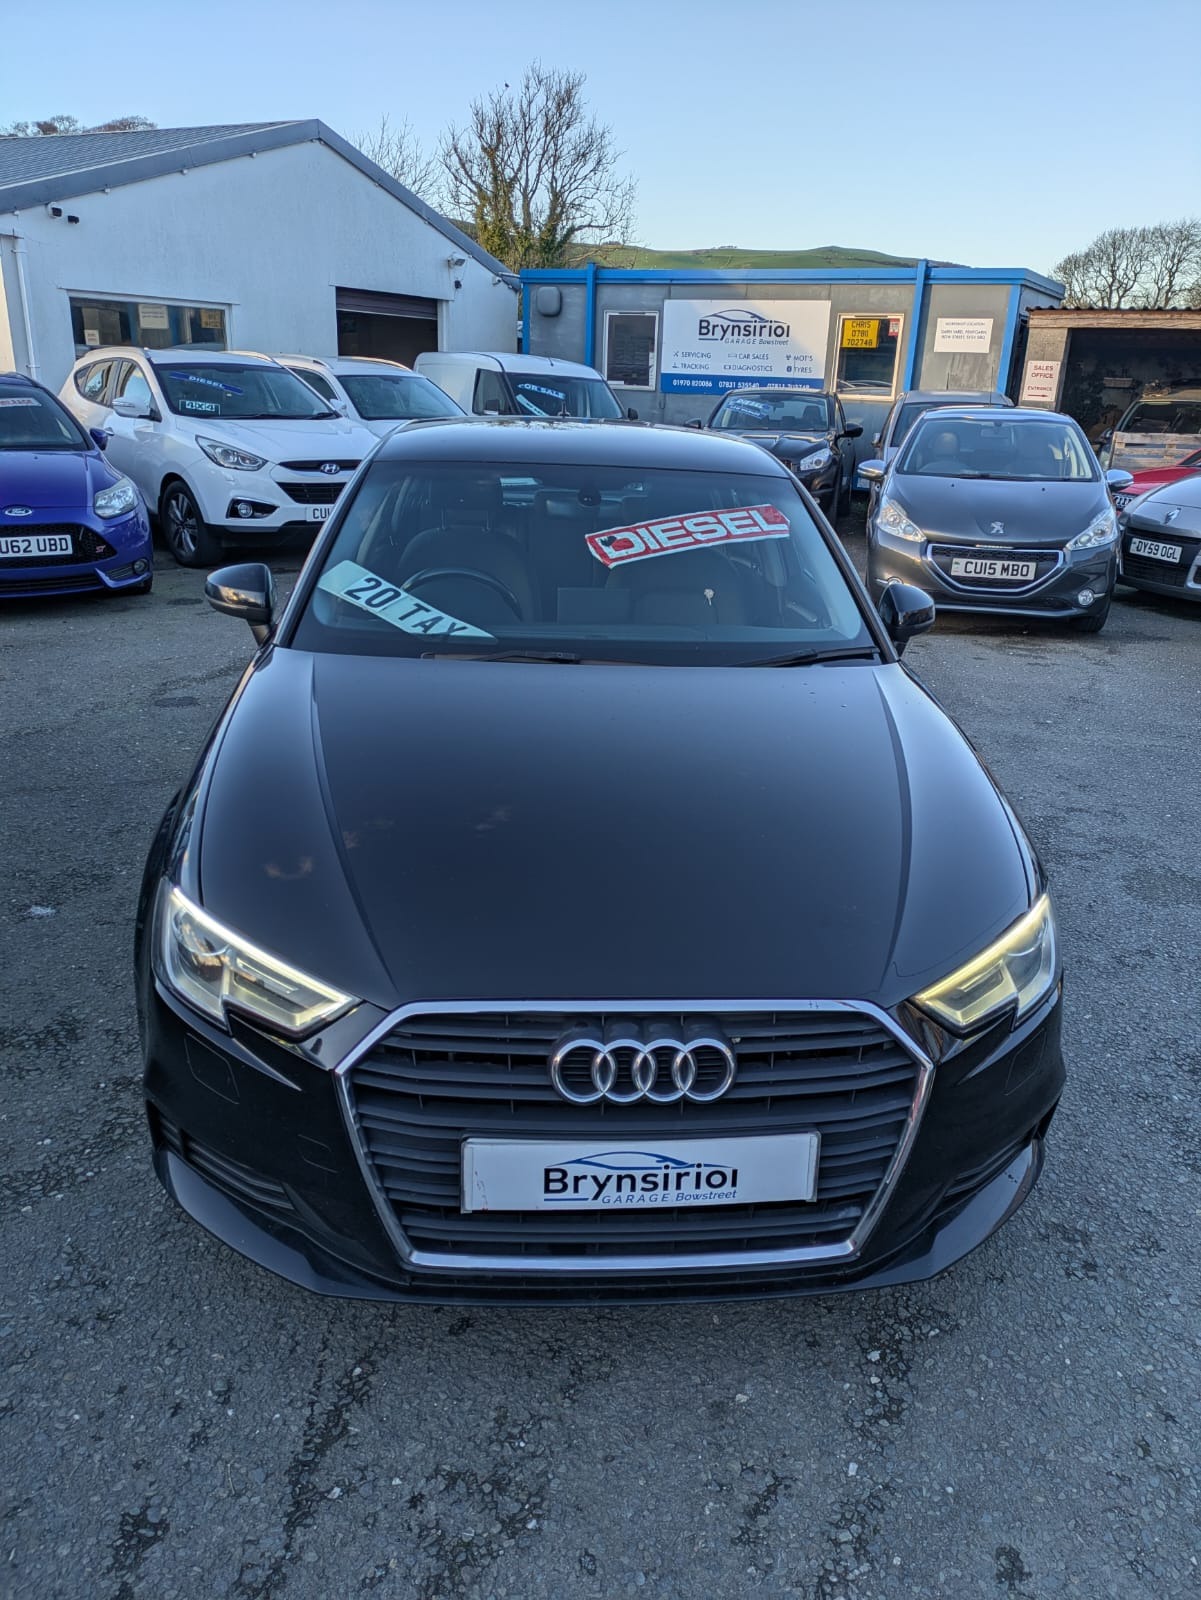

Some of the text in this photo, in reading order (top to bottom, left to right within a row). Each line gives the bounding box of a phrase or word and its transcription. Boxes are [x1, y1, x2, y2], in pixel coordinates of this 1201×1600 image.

[698, 319, 790, 341] Brynsiriol
[681, 351, 712, 359] SERVICING
[752, 353, 769, 361] SALES
[680, 362, 710, 370] TRACKING
[732, 364, 773, 372] DIAGNOSTICS
[794, 366, 812, 374] TYRES
[594, 509, 789, 560] DIESEL
[36, 537, 69, 553] UBD
[1136, 541, 1160, 556] DY59
[963, 560, 998, 576] CU15
[344, 576, 402, 609] 20
[543, 1163, 738, 1201] Brynsiriol
[601, 1189, 737, 1204] GARAGE Bowstreet
